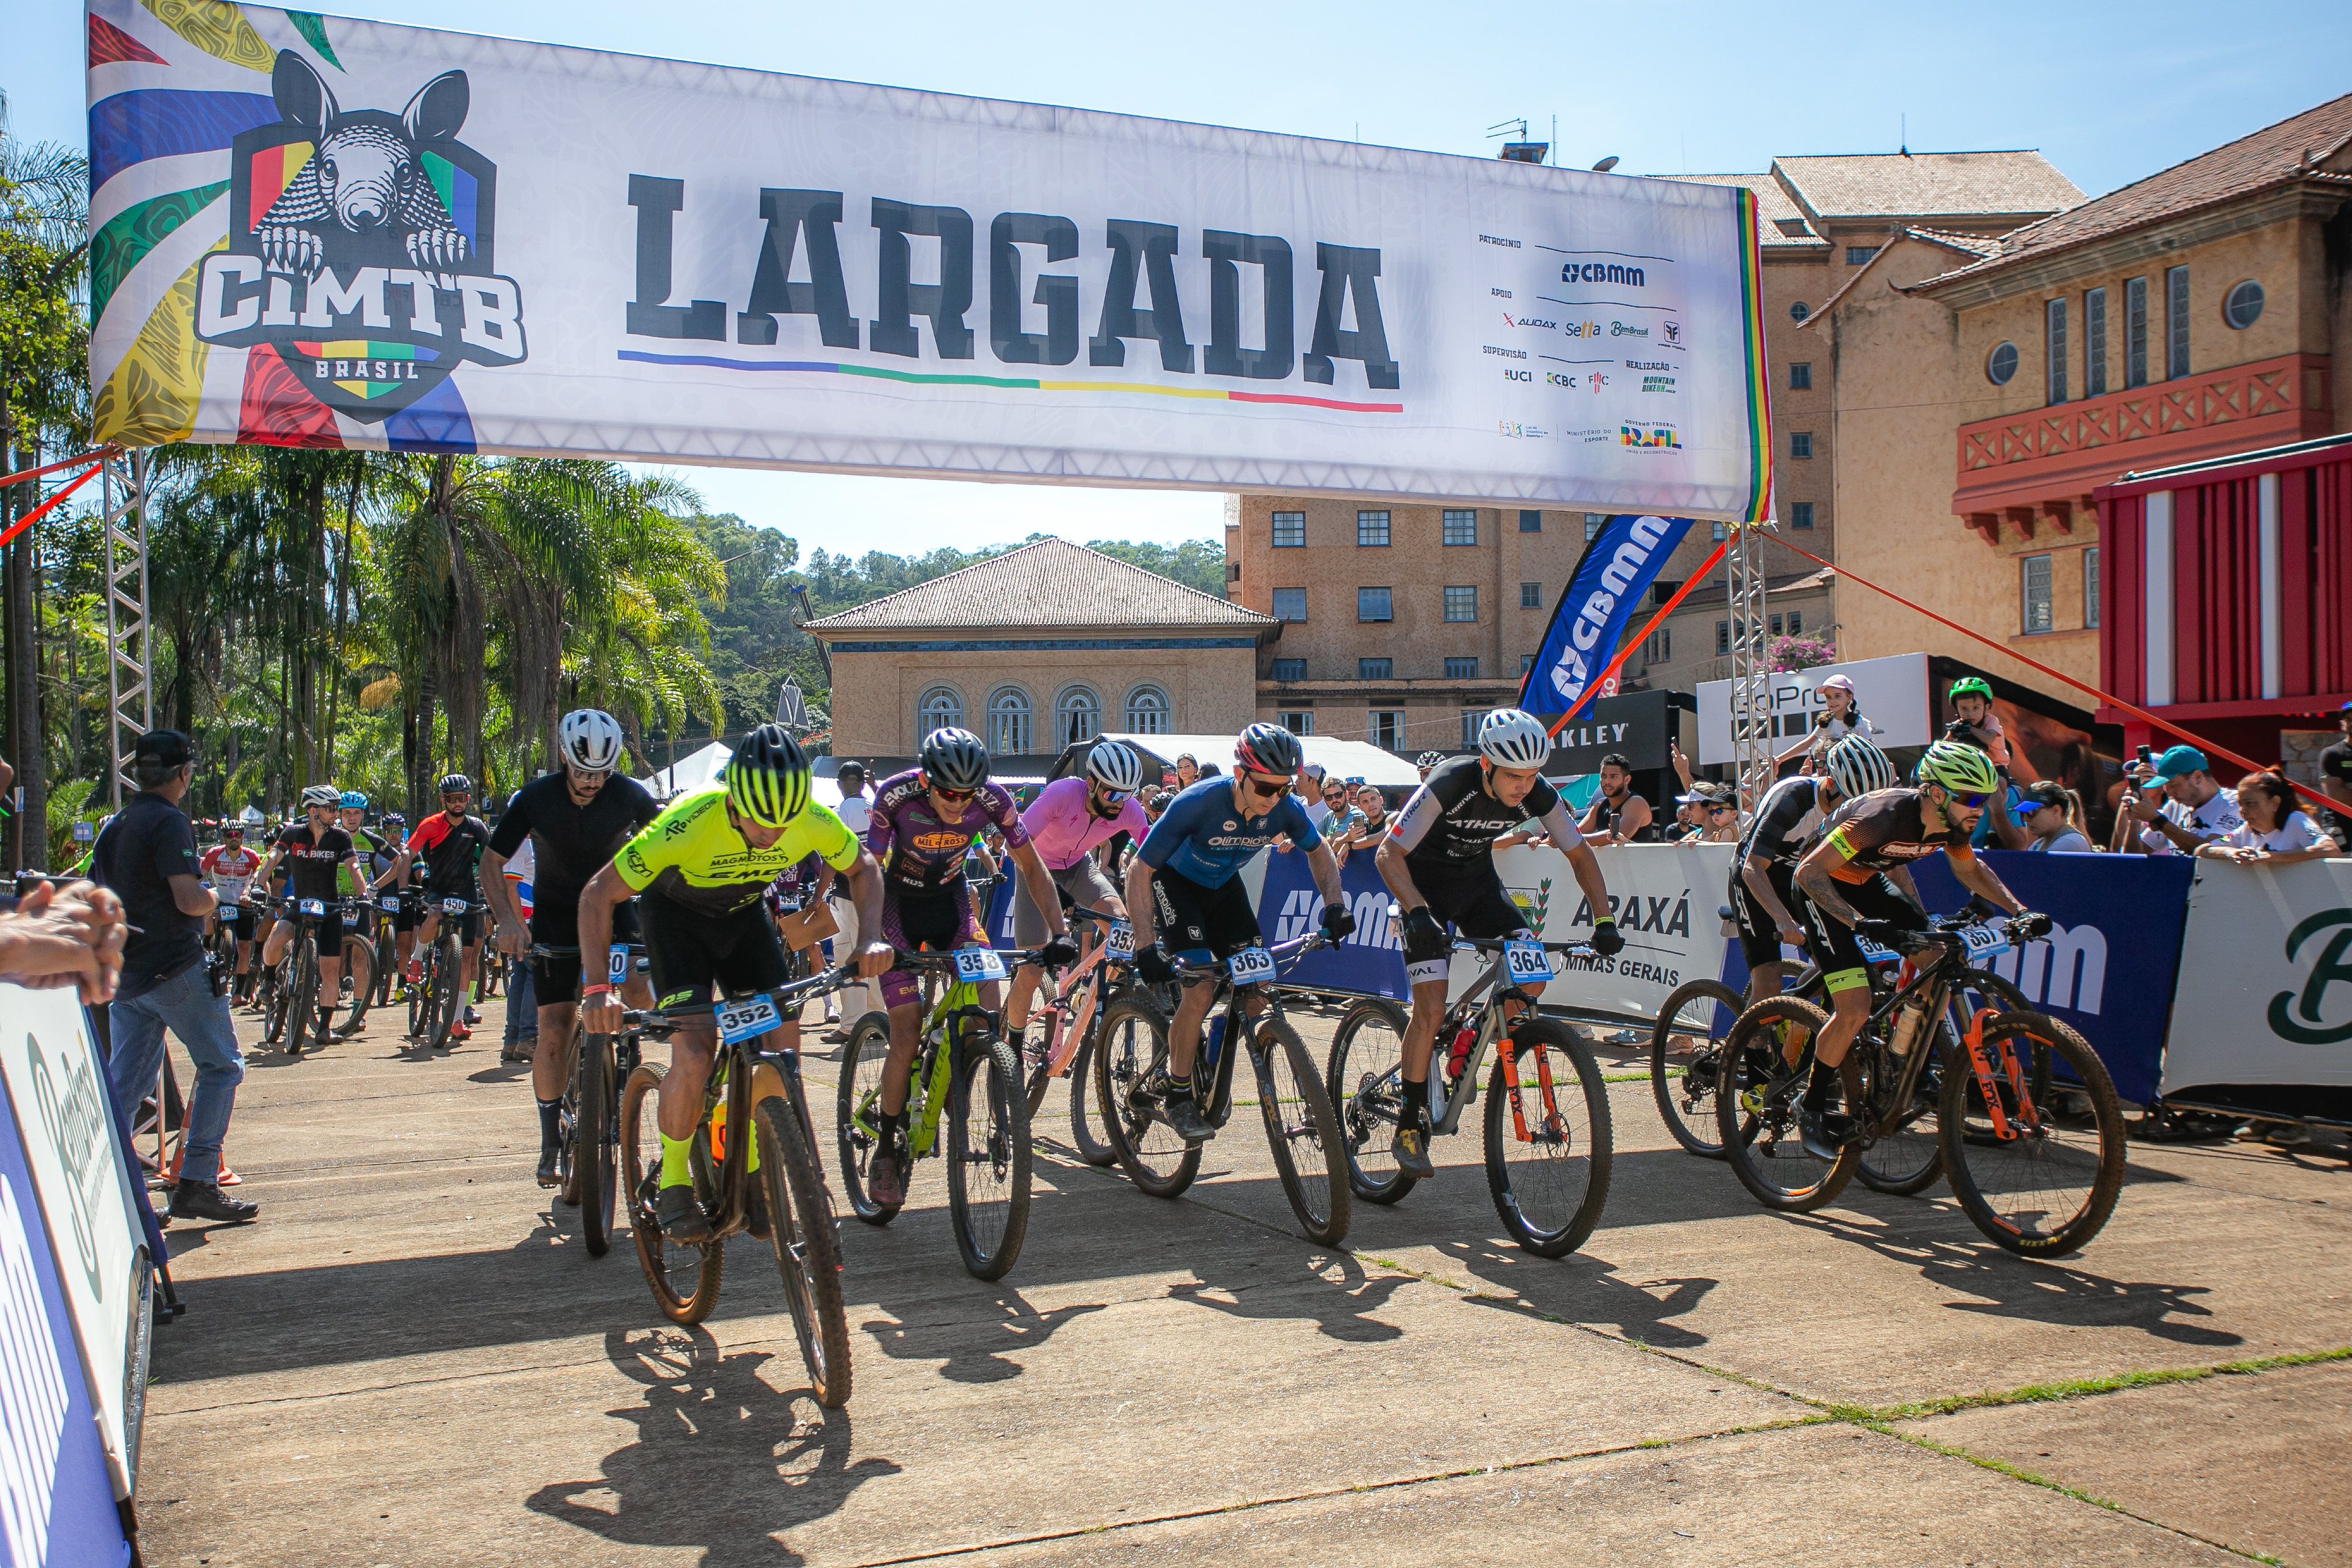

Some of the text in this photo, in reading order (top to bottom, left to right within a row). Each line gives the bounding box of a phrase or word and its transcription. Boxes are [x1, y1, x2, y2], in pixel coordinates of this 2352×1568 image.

[1479, 234, 1521, 248] PATROCÍNIO
[626, 174, 1399, 389] LARGADA
[1491, 288, 1512, 299] APOIO
[1518, 318, 1557, 330] AUDAX
[1565, 320, 1600, 339] Setta
[1483, 346, 1527, 359] SUPERVISÃO
[315, 360, 419, 380] BRASIL
[1626, 360, 1669, 371] REALIZAÇÃO
[1509, 370, 1532, 382] UCI
[1554, 374, 1576, 388] CBC
[1643, 377, 1675, 385] MOUNTAIN
[1620, 426, 1682, 449] BRASIL
[1550, 723, 1626, 749] KLEY
[943, 835, 967, 845] ROSS
[310, 851, 335, 859] BIKES
[221, 908, 236, 916] 535
[302, 901, 322, 910] 443
[960, 954, 1000, 973] 358
[1235, 953, 1270, 973] 363
[1510, 951, 1546, 973] 364
[1619, 959, 1680, 988] GERAIS
[721, 1005, 773, 1030] 352
[1507, 1085, 1523, 1114] FOX
[1982, 1081, 2000, 1111] FOX
